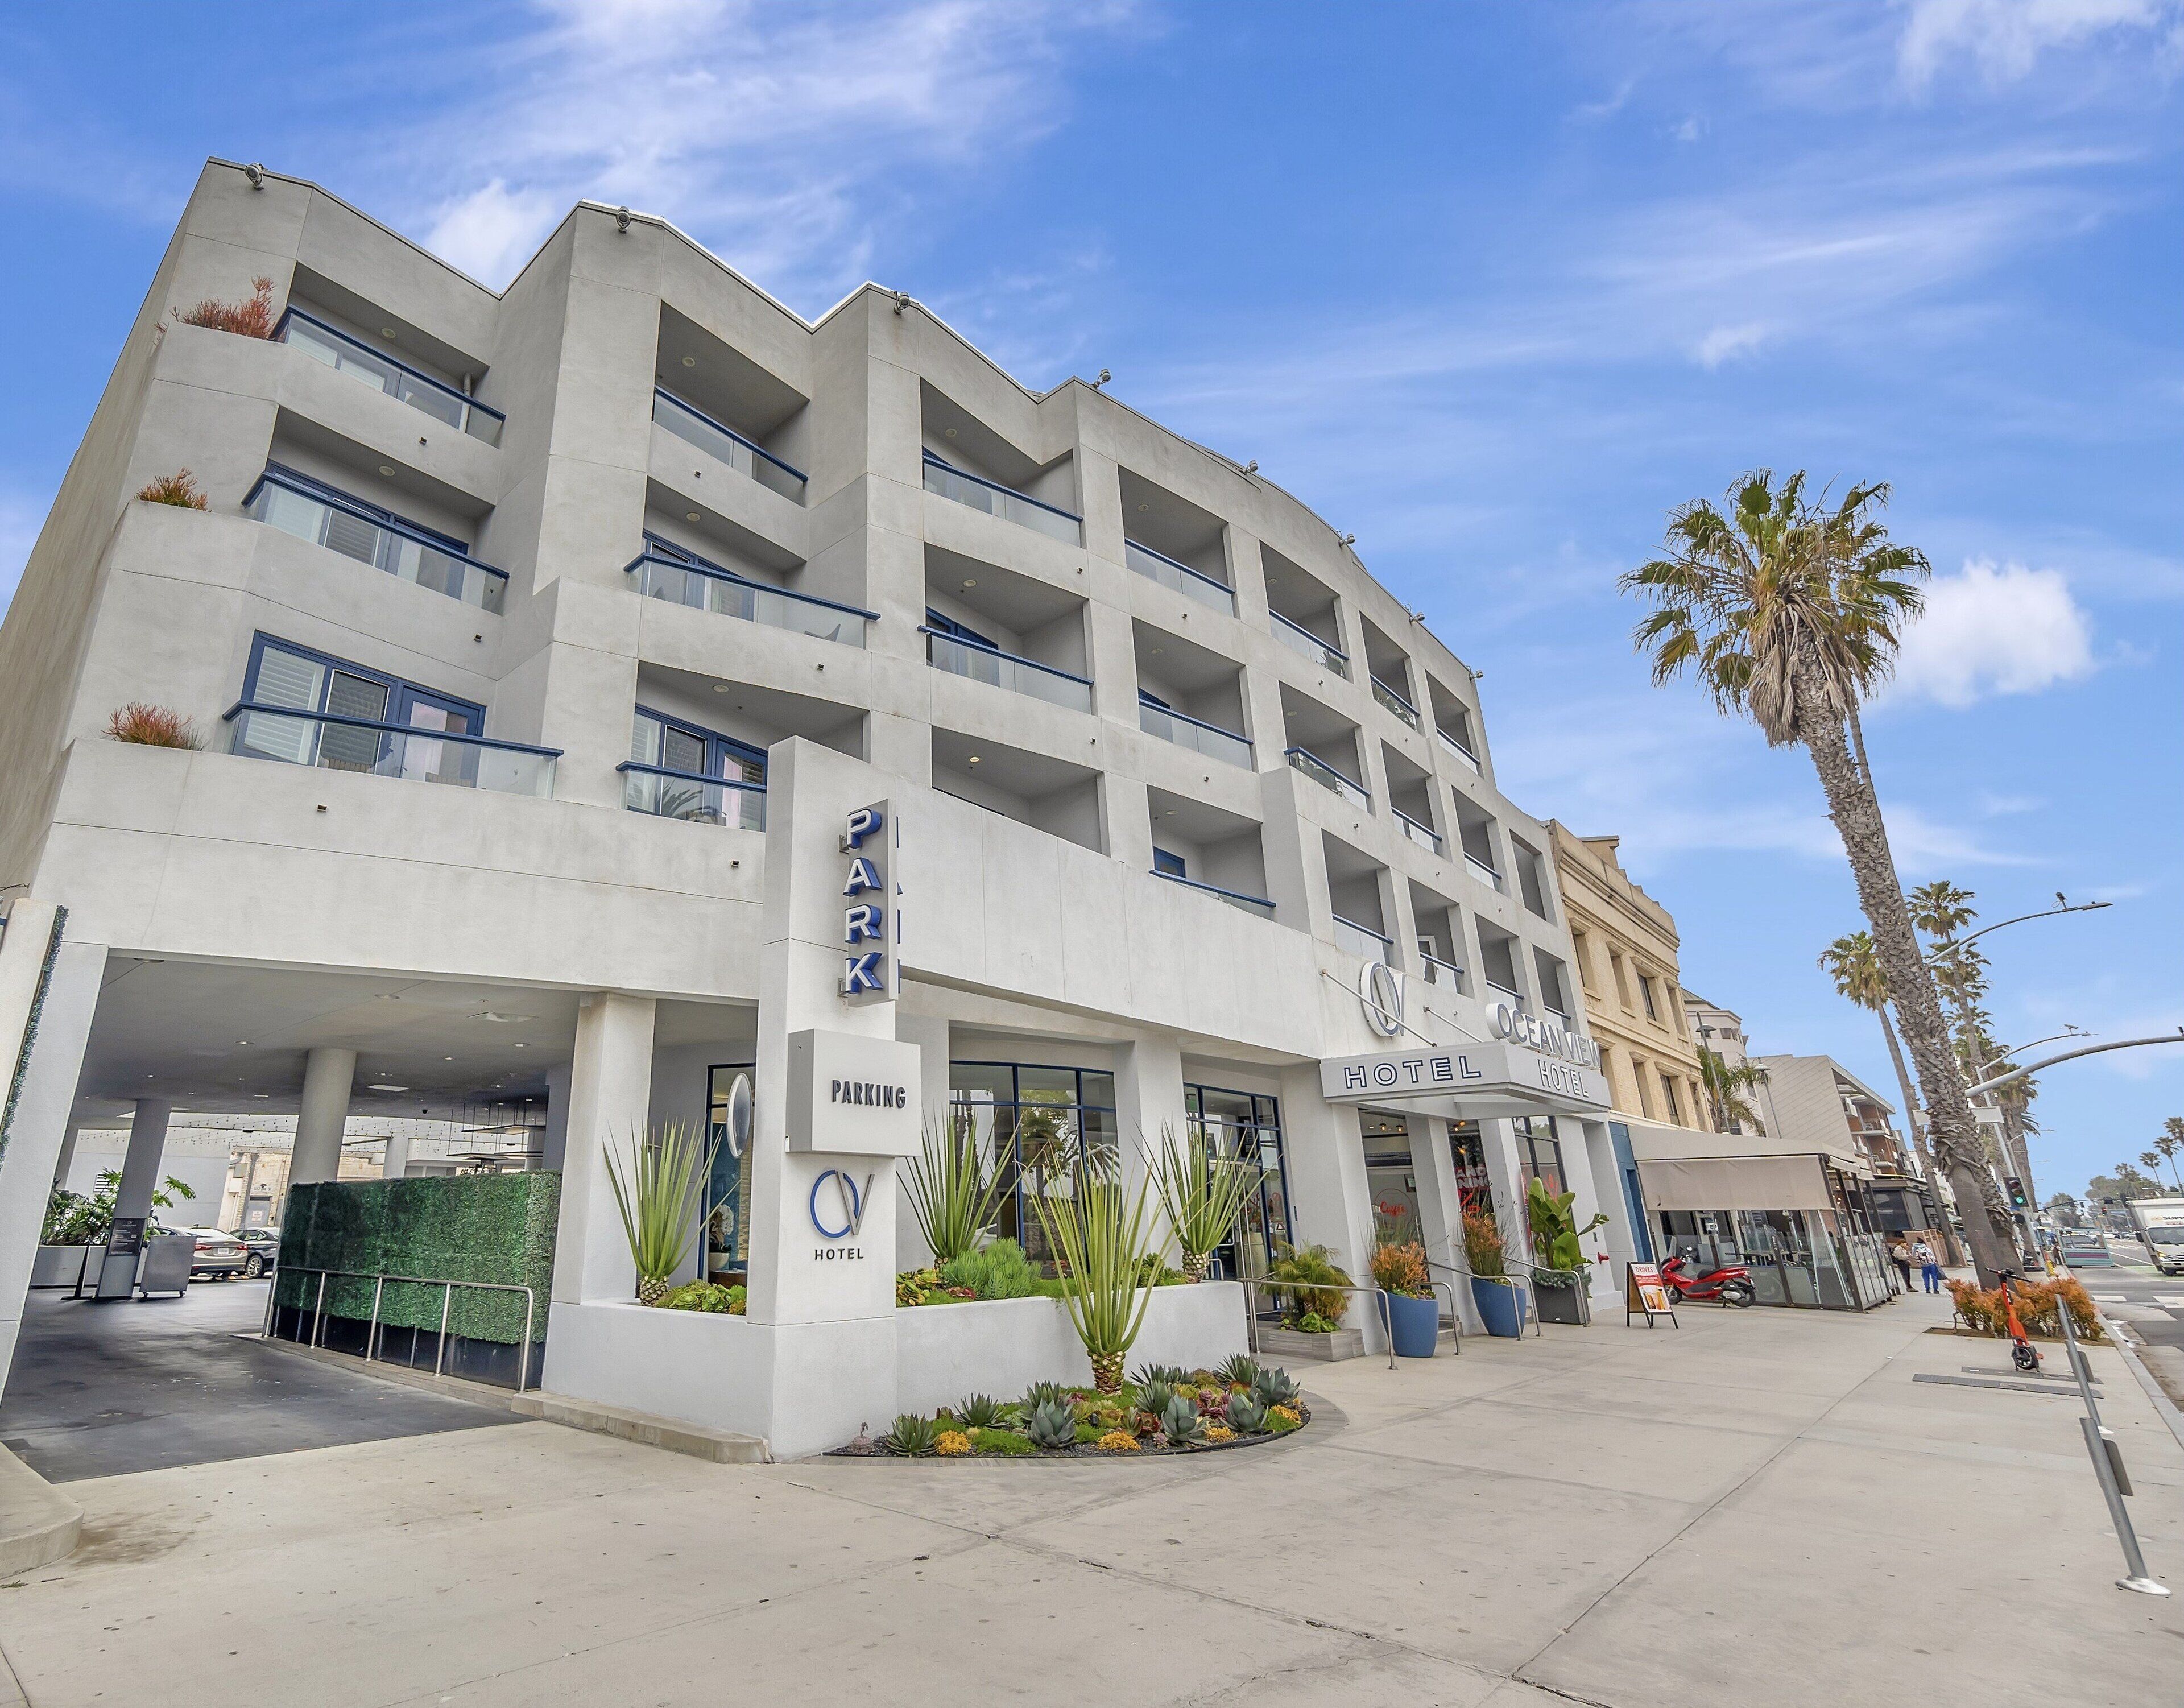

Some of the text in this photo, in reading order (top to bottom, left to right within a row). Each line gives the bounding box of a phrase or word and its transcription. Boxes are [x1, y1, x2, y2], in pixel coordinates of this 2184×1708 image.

[842, 808, 883, 995] PARK
[1490, 1003, 1601, 1070] OCEAN VIEW
[1344, 1056, 1482, 1089] HOTEL
[1537, 1058, 1589, 1098] HOTEL
[832, 1080, 906, 1109] PARKING
[810, 1169, 875, 1239] OV
[814, 1248, 864, 1260] HOTEL
